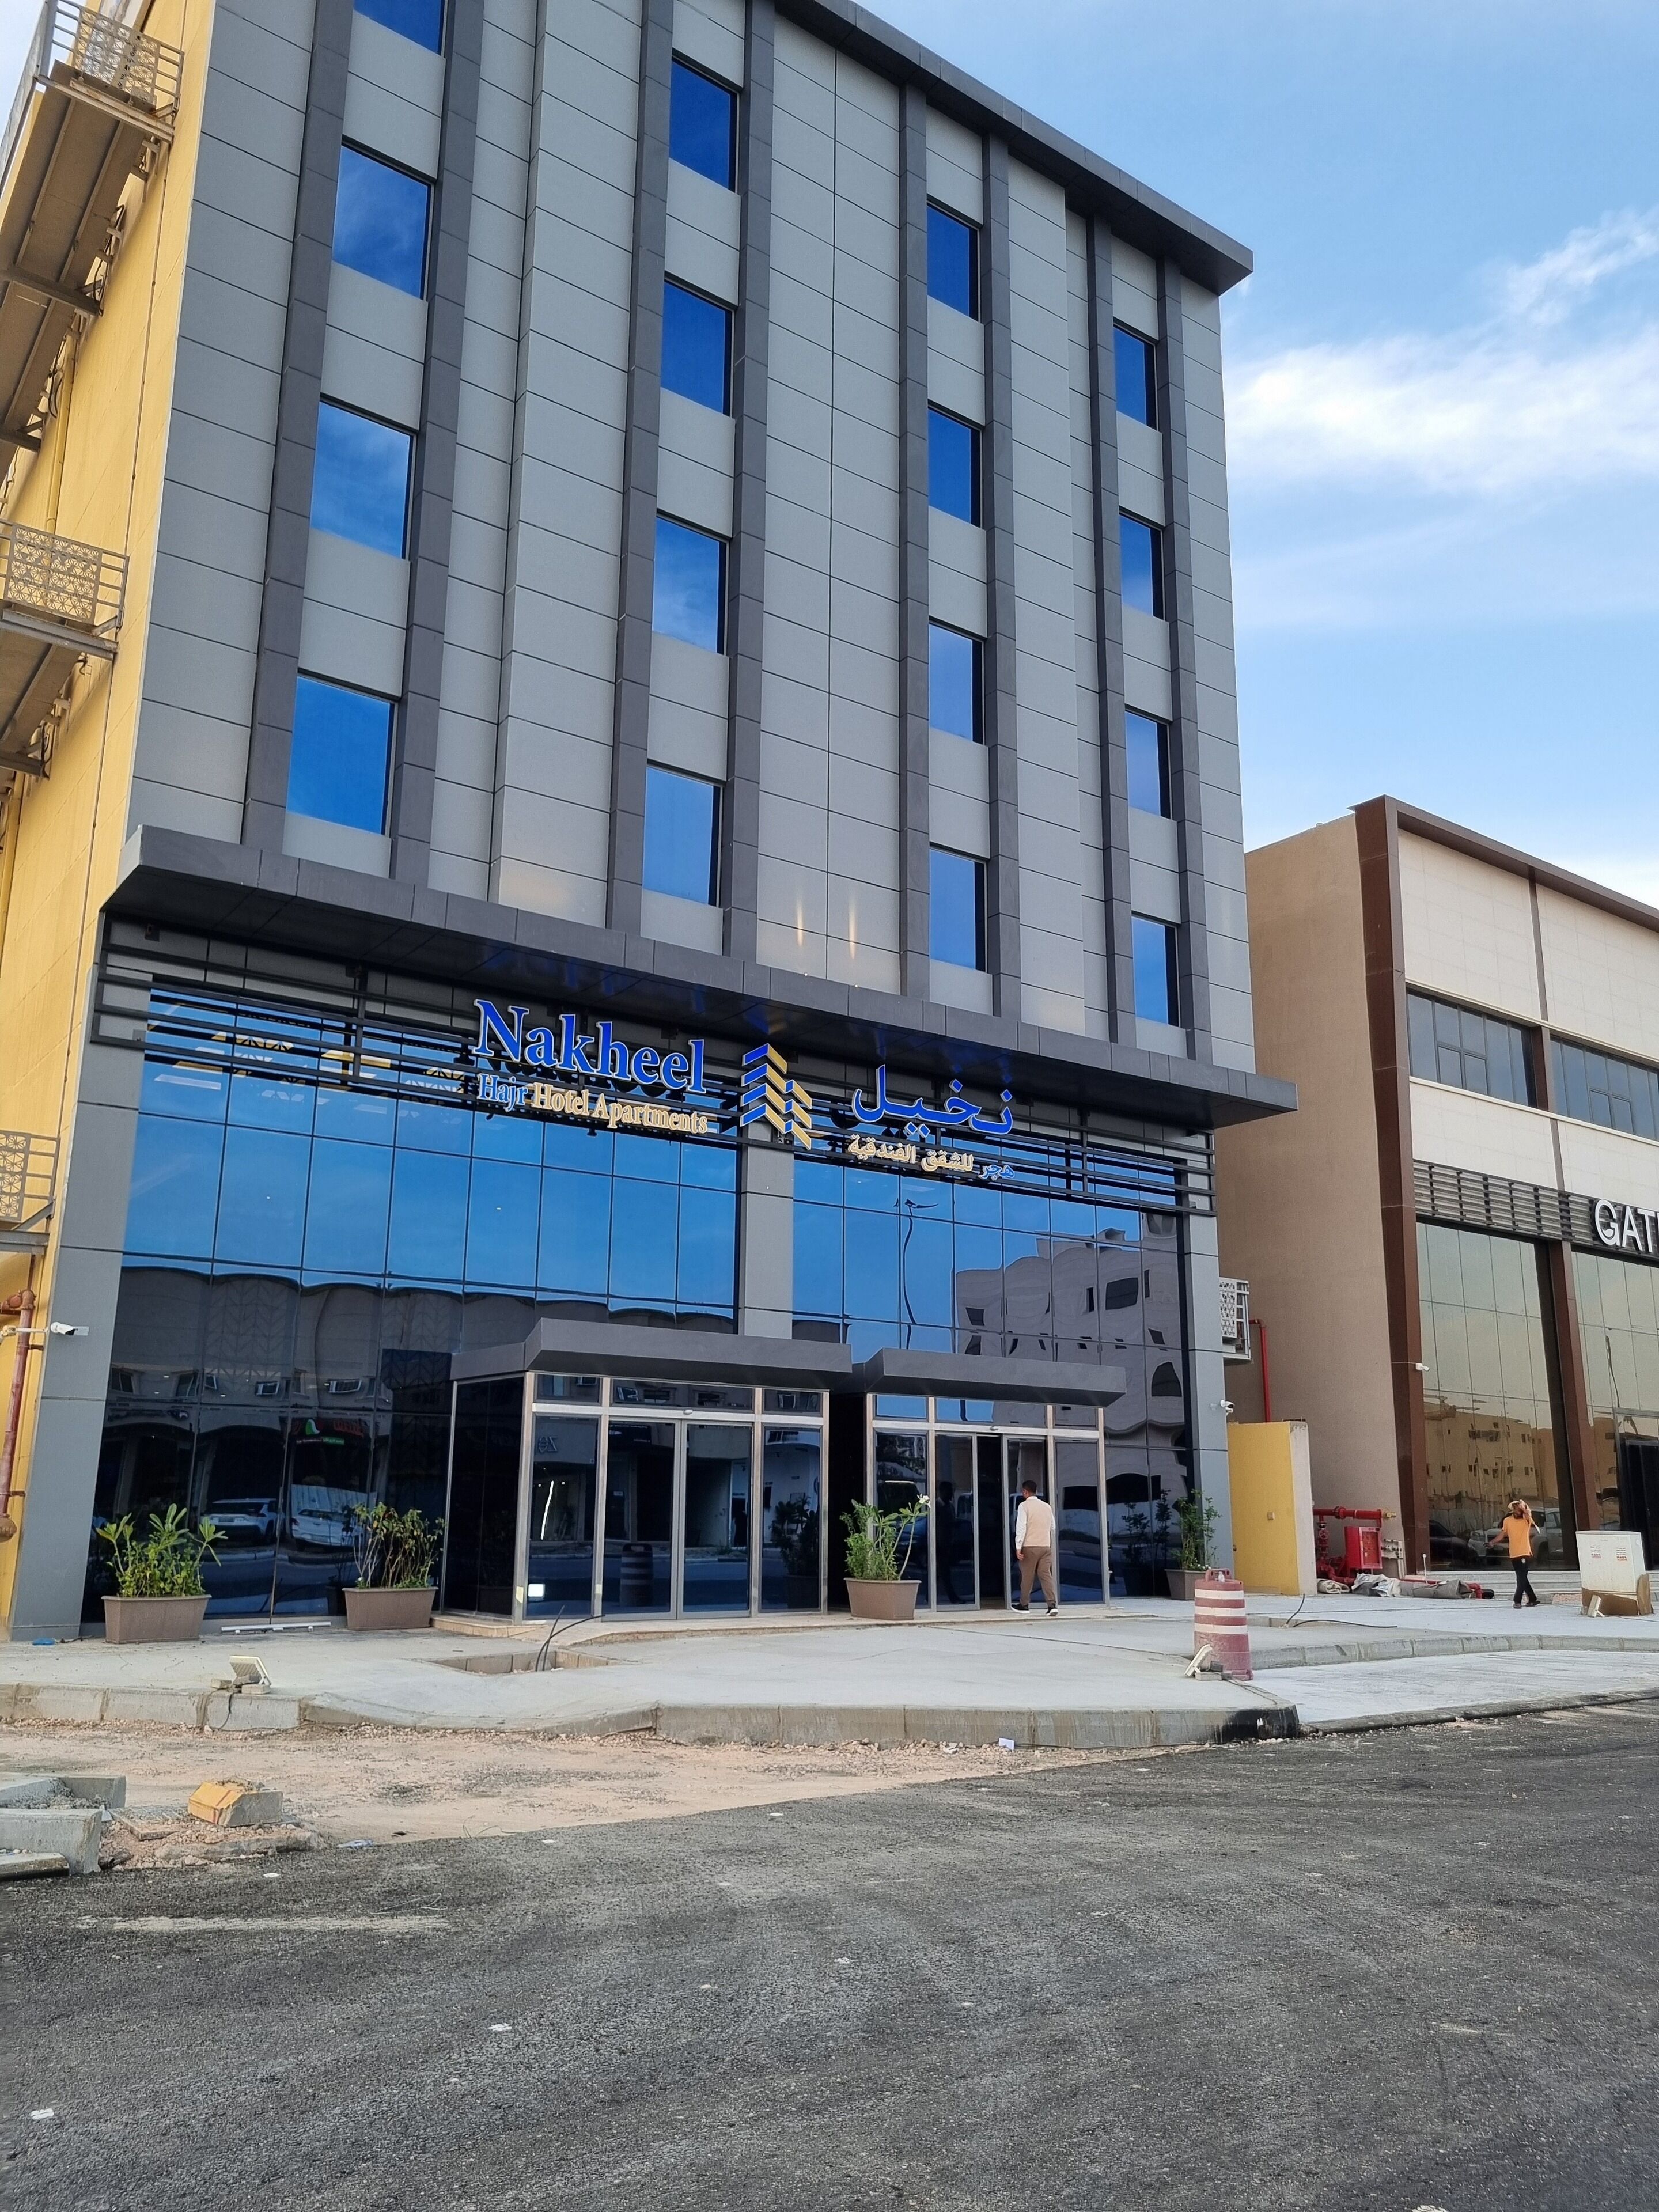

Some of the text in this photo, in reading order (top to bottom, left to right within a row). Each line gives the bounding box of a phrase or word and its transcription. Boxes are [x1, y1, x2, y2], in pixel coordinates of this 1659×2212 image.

[471, 998, 707, 1093] Nakheel
[476, 1073, 708, 1134] Hajr Hotel Apartments
[851, 1063, 1014, 1138] نخيل
[847, 1134, 1016, 1180] هجر للشقق الفندقية
[1594, 1198, 1659, 1253] GAT
